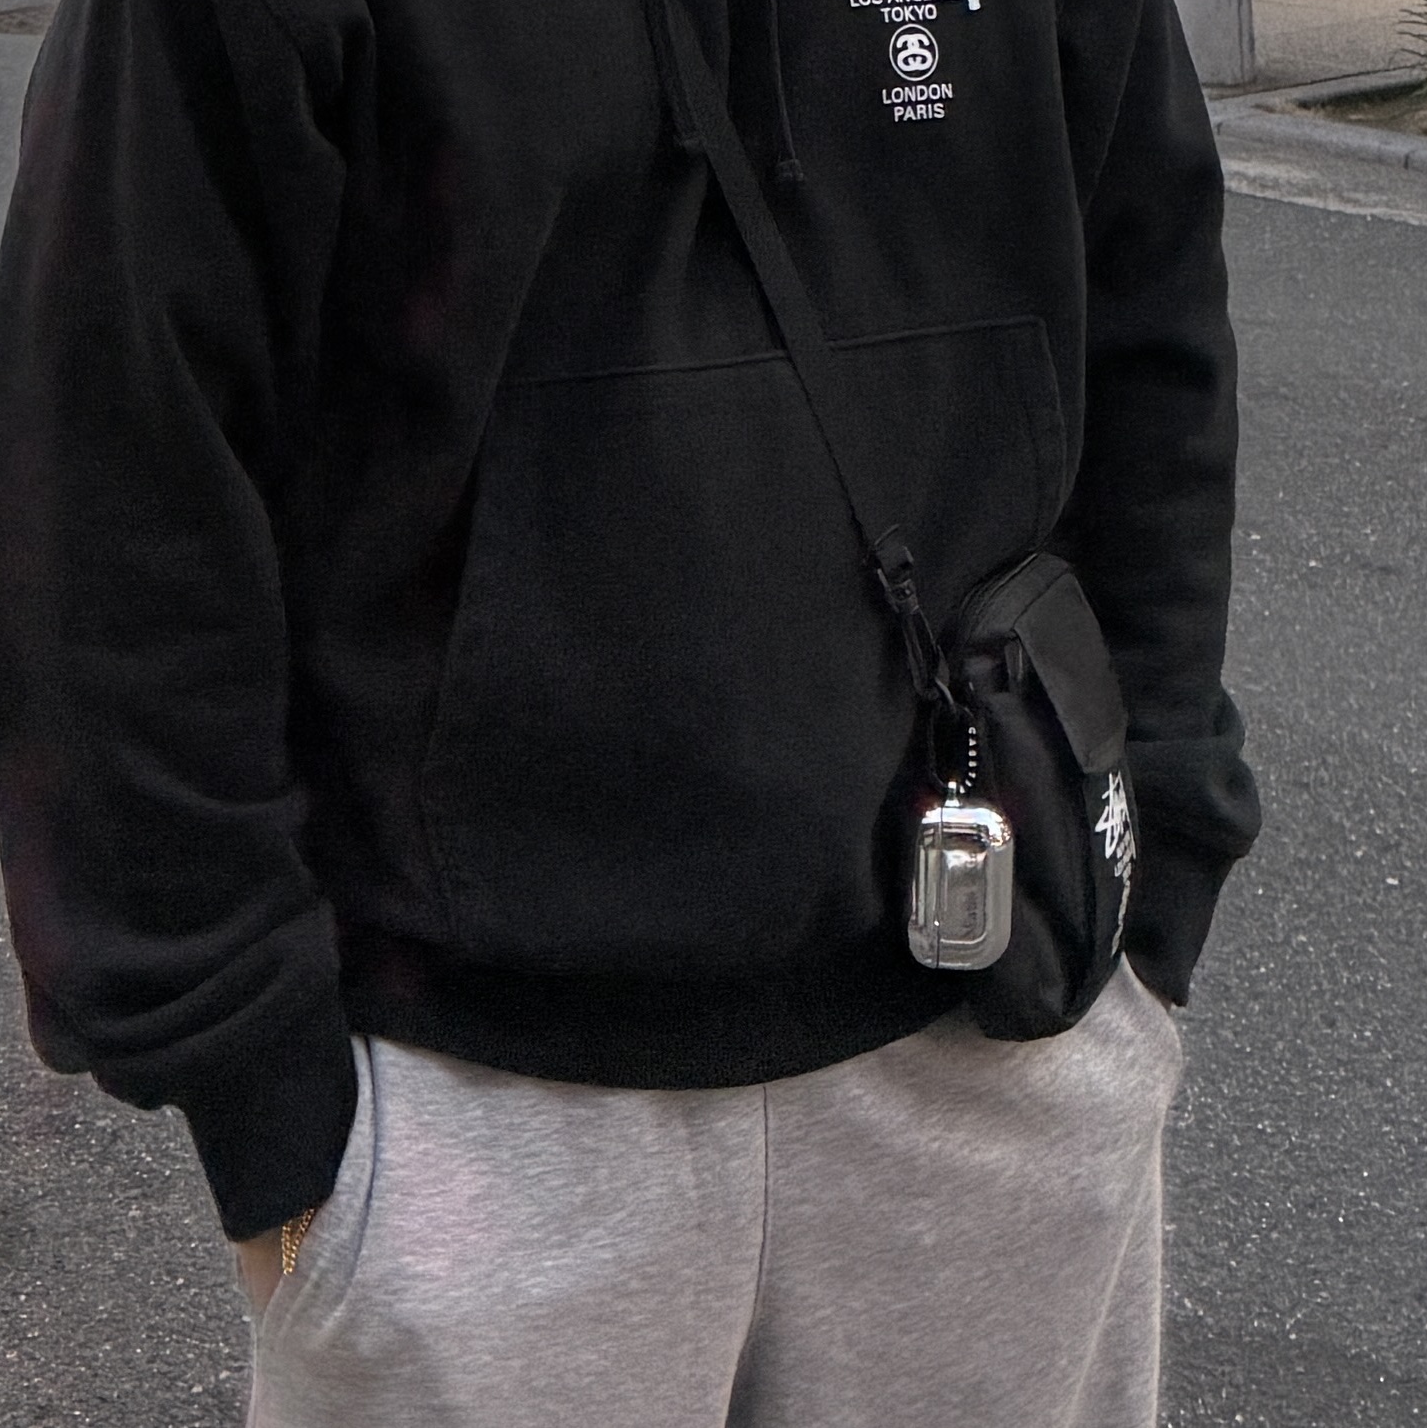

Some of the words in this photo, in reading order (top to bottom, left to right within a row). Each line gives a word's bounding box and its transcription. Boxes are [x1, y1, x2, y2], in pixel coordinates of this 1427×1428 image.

[880, 3, 938, 24] TOKYO
[882, 83, 954, 105] LONDON
[894, 102, 945, 123] PARIS
